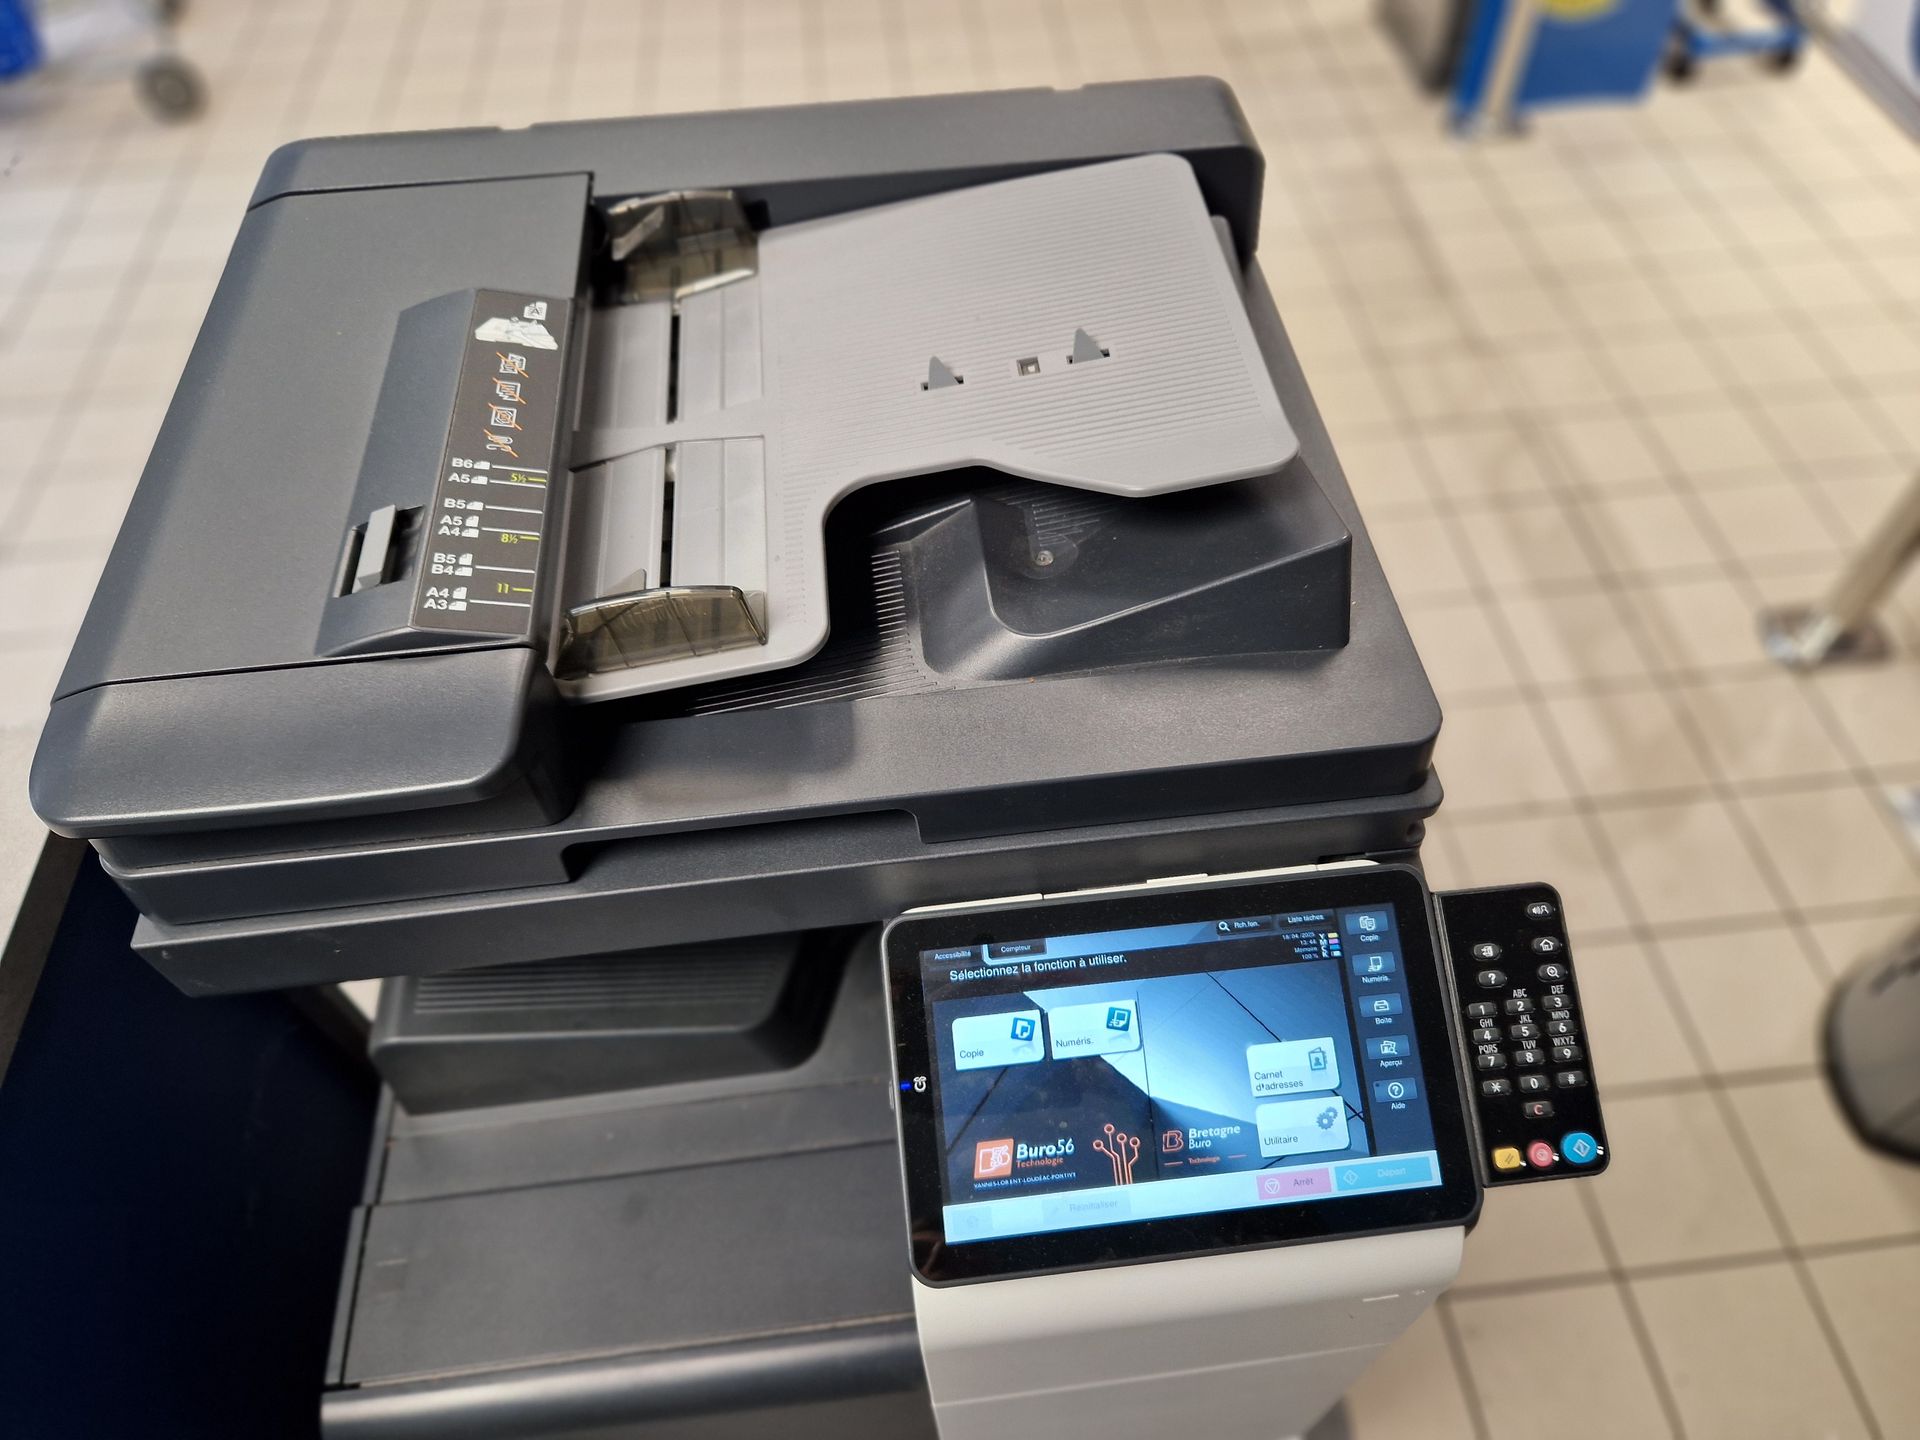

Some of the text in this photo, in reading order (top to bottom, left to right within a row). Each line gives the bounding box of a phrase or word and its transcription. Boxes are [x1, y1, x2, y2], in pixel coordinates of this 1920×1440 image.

[451, 458, 474, 468] B6
[448, 472, 471, 484] A5
[443, 498, 467, 510] B5
[440, 515, 463, 526] A5
[438, 526, 461, 537] A4
[433, 552, 457, 564] B5
[431, 563, 455, 576] B4
[426, 586, 450, 598] A4
[423, 598, 448, 610] A3
[1360, 934, 1379, 943] Copie
[1000, 944, 1031, 953] Compteur
[949, 953, 1127, 981] Sélectionnez la fonction à utiliser.
[1512, 988, 1528, 998] ABC
[1551, 984, 1565, 994] DEF
[1516, 1000, 1525, 1012] 2
[1553, 997, 1563, 1008] 3
[1479, 1004, 1486, 1016] 1
[1551, 1010, 1570, 1020] MNO
[1479, 1018, 1494, 1028] GHI
[1519, 1014, 1533, 1024] JKL
[1521, 1026, 1531, 1037] 5
[1558, 1022, 1568, 1033] 6
[1483, 1029, 1493, 1041] 4
[1552, 1035, 1576, 1047] WXYZ
[1055, 1036, 1095, 1049] Numéris.
[1521, 1039, 1537, 1050] TUV
[959, 1048, 985, 1060] Copie
[1478, 1043, 1498, 1055] PQRS
[1562, 1048, 1572, 1060] 9
[1380, 1059, 1403, 1068] Aperçu
[1487, 1055, 1496, 1068] 7
[1525, 1051, 1535, 1064] 8
[1254, 1070, 1283, 1080] Carnet
[1255, 1080, 1304, 1092] d'adresses
[1529, 1077, 1540, 1090] 0
[1391, 1102, 1406, 1110] Aide
[1533, 1104, 1544, 1116] C
[1188, 1125, 1241, 1139] Bretagne
[1188, 1138, 1212, 1149] Buro
[1263, 1134, 1299, 1146] Utilitaire
[1017, 1138, 1075, 1159] Buro56
